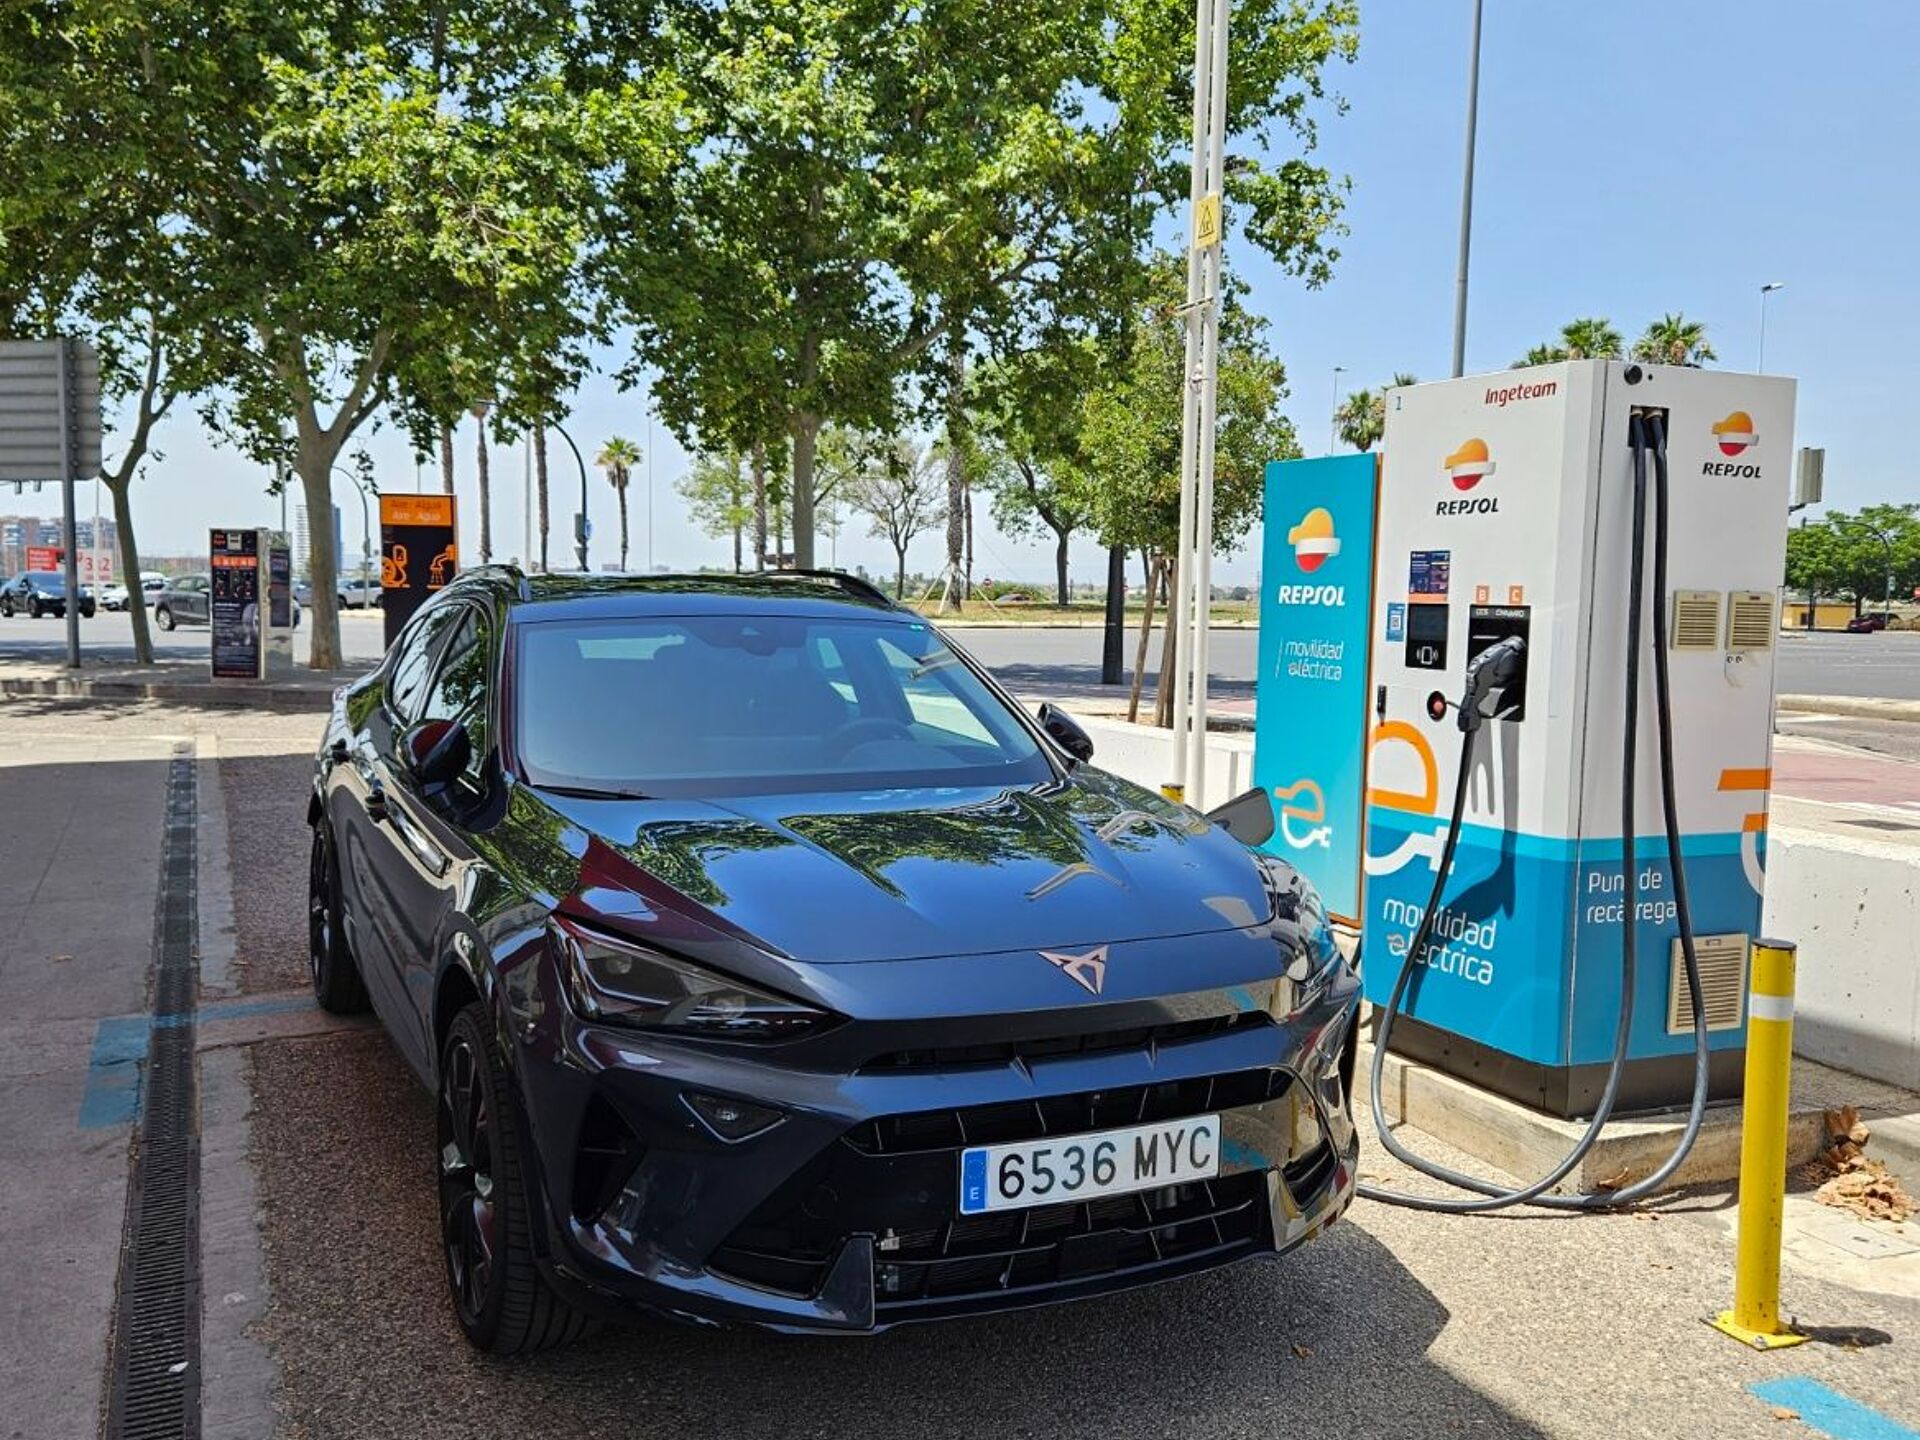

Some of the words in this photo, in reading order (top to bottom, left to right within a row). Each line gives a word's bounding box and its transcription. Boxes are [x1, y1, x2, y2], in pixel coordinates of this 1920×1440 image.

[1485, 381, 1557, 407] Ingeteam
[1702, 461, 1762, 479] REPSOL
[1436, 498, 1499, 516] REPSOL
[1278, 585, 1346, 606] REPSOL
[1285, 639, 1344, 660] movilidad
[1588, 872, 1630, 894] Pun
[1639, 866, 1662, 891] de
[1587, 898, 1677, 925] recàrega
[999, 1141, 1117, 1199] 6536
[1133, 1125, 1211, 1181] MYC
[969, 1186, 979, 1200] E
